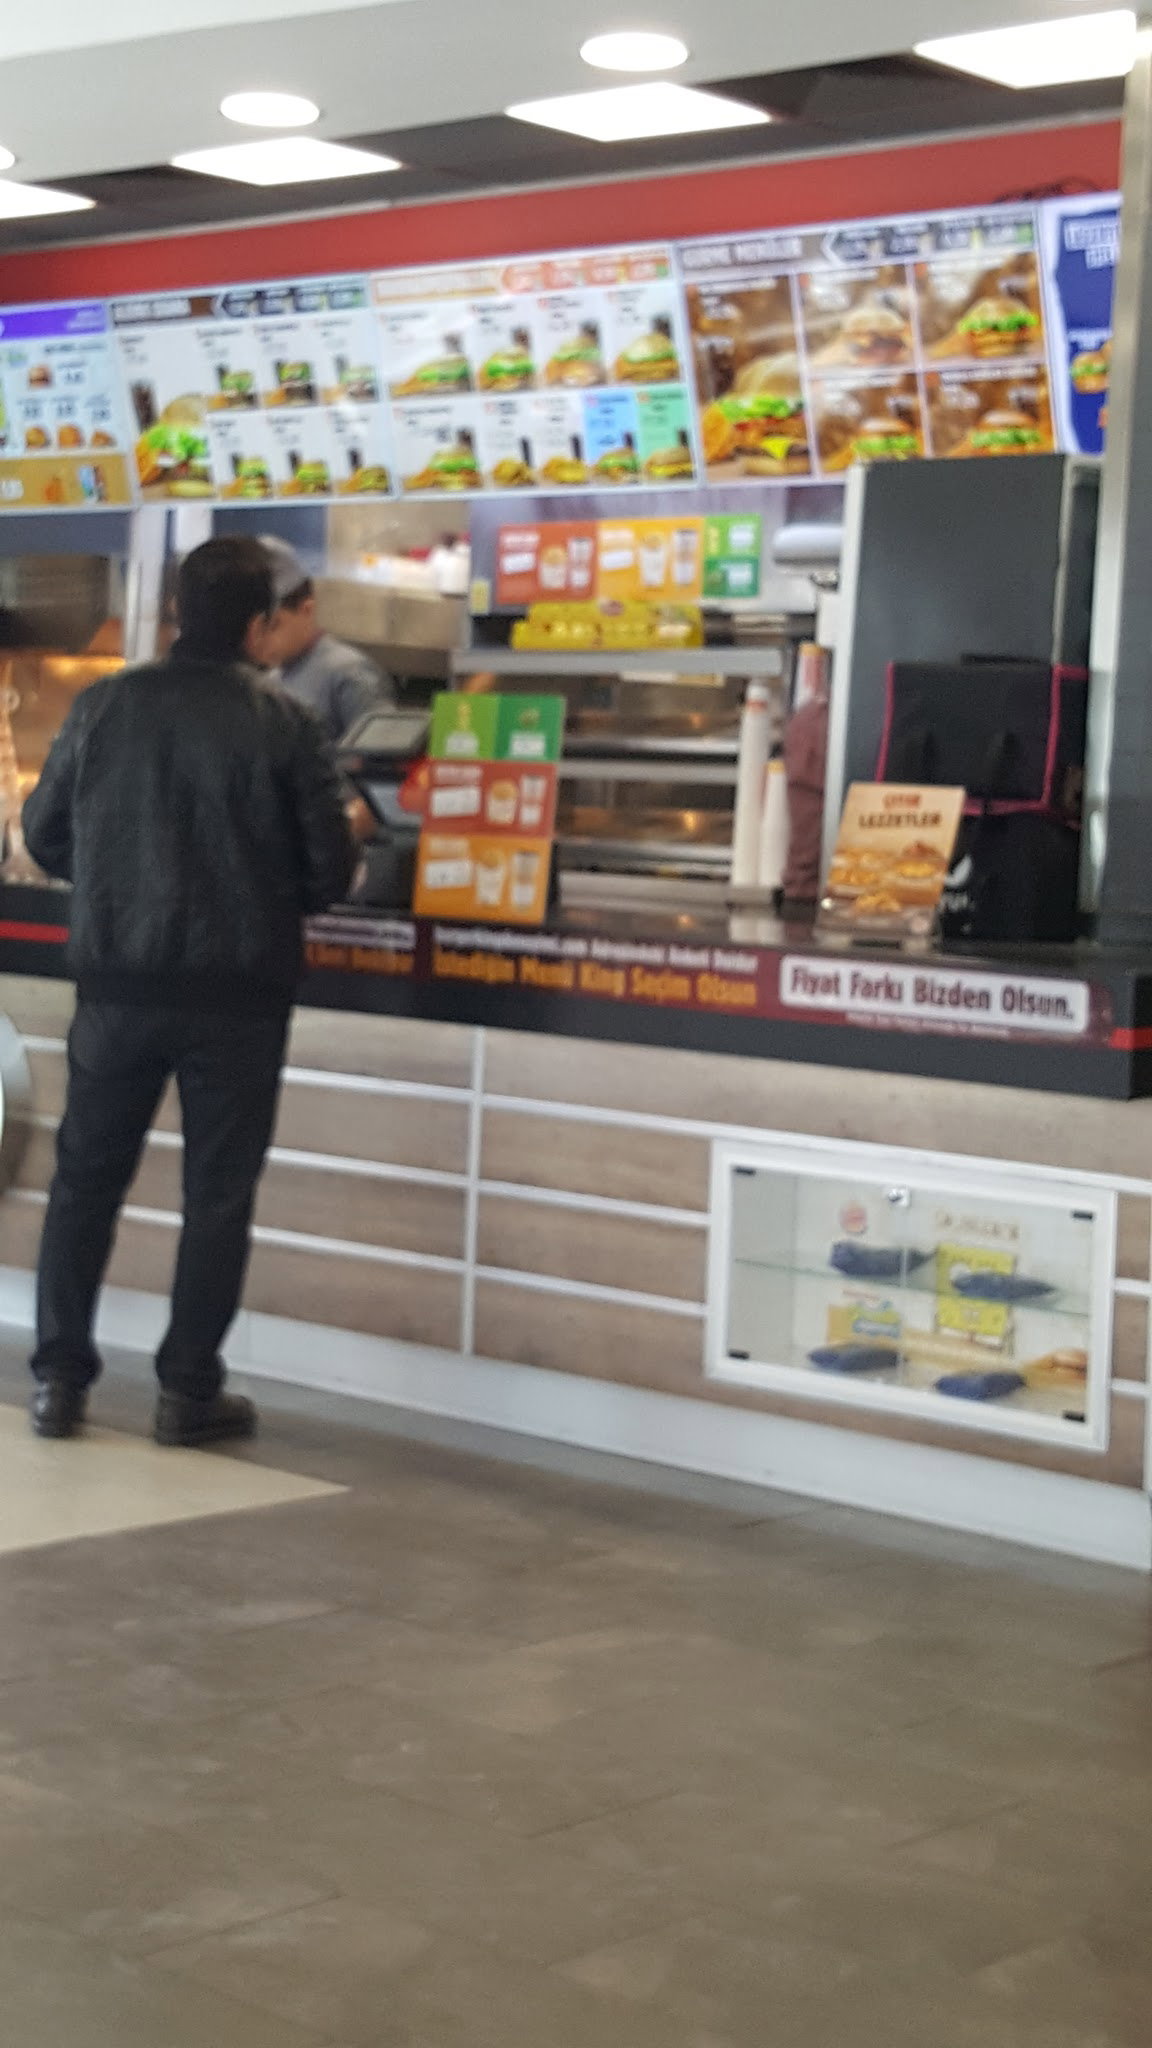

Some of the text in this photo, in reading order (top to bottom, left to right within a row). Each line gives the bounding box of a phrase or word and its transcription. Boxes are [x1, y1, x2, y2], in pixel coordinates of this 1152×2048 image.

[858, 812, 942, 829] LEZZETLER
[521, 956, 574, 989] Menü
[580, 961, 626, 998] King
[697, 973, 757, 1005] Olsun
[790, 967, 1074, 1019] Fiyat Farkı Bizden Olsun.
